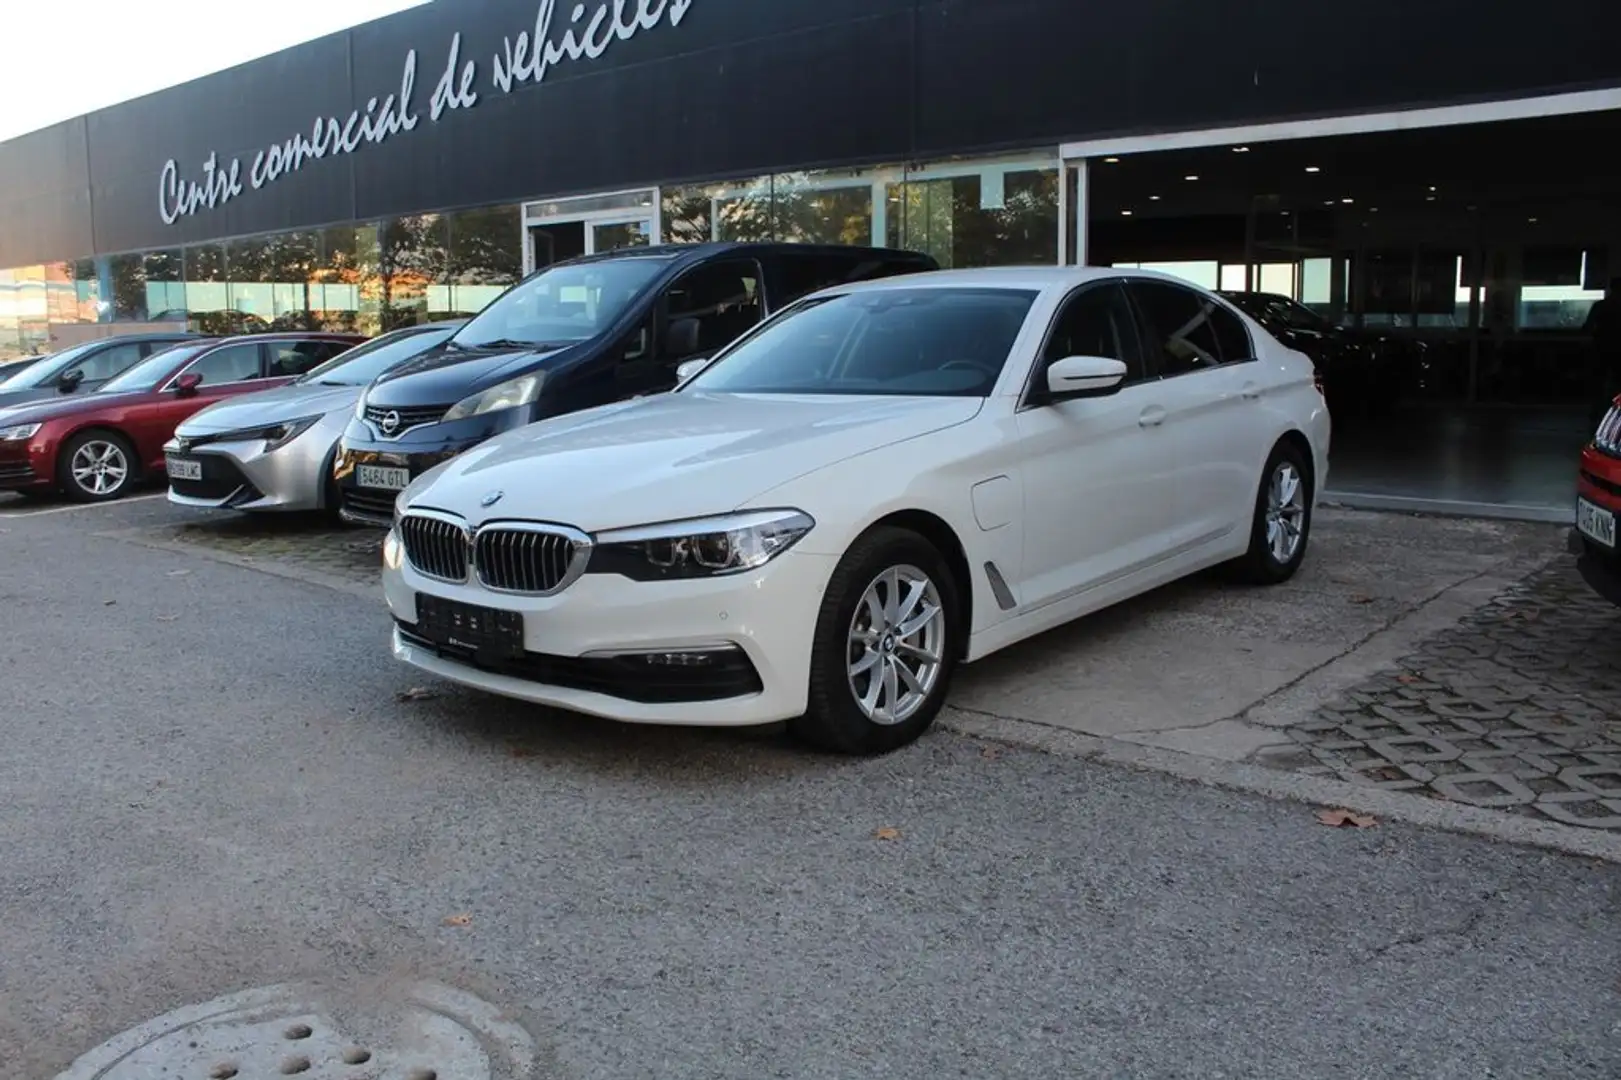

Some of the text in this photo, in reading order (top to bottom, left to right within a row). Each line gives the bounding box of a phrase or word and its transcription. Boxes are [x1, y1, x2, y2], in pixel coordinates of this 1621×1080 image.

[160, 150, 242, 225] Centre
[251, 49, 418, 189] comercial
[430, 32, 477, 122] de
[362, 466, 407, 488] 5464 GTL
